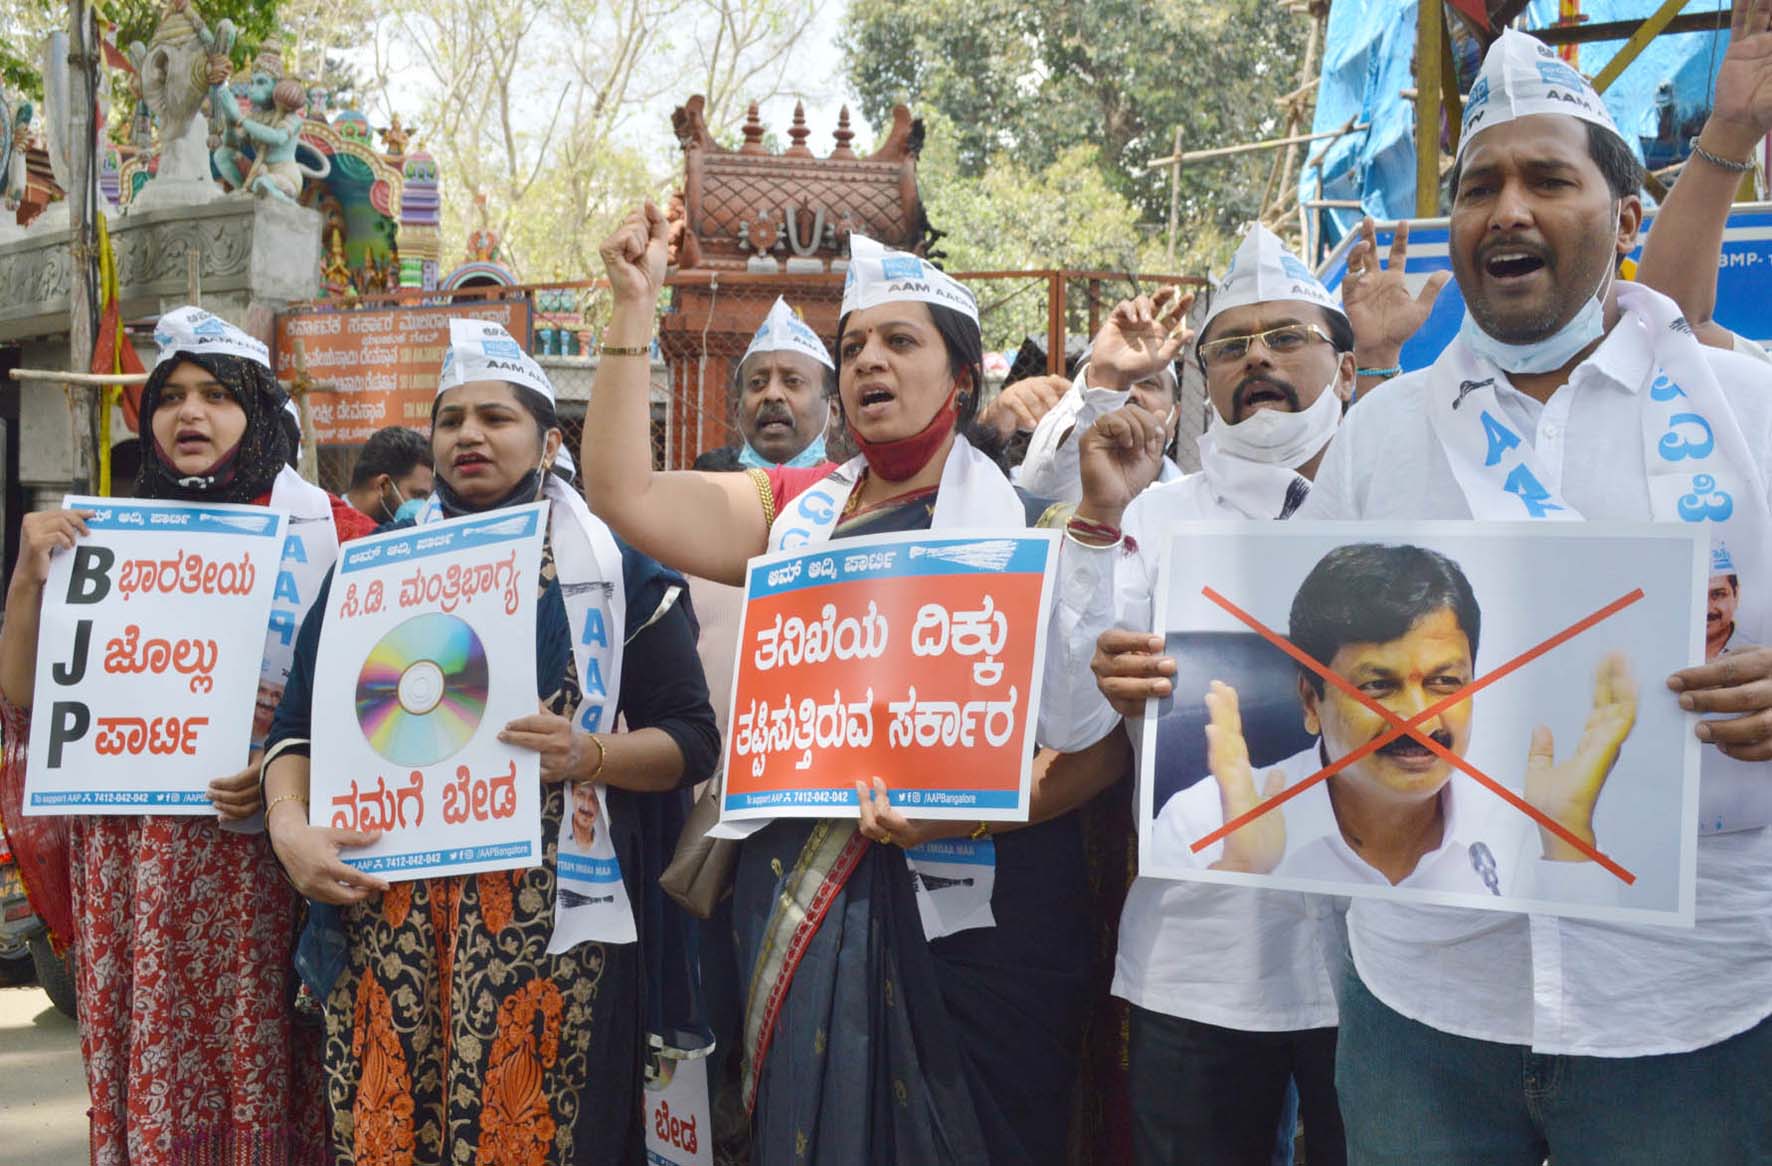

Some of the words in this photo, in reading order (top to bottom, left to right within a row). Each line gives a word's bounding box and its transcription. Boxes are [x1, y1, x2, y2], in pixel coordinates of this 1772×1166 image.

[888, 281, 930, 293] AAM
[487, 360, 525, 374] AAM
[65, 545, 116, 605] B
[118, 549, 256, 602] ಭಾರತೀಯ
[339, 578, 387, 620] ಸಿ.ಡಿ.
[399, 548, 521, 616] ಮಂತ್ರಿಭಾಗ್ಯ
[844, 551, 897, 573] ಪಾರ್ಟಿ
[52, 619, 94, 686] J
[103, 624, 219, 693] ಜೊಲ್ಲು
[754, 600, 889, 671] ತನಿಖೆಯ
[911, 594, 1008, 686] ದಿಕ್ಕು
[46, 700, 91, 769] P
[94, 716, 210, 756] ಪಾರ್ಟಿ
[736, 686, 874, 778] ತಪ್ಪಿಸುತ್ತಿರುವ
[888, 685, 1018, 750] ಸರ್ಕಾರ
[94, 792, 149, 802] 7412-042-042
[331, 770, 425, 833] ನಮಗೆ
[442, 759, 517, 825] ಬೇಡ
[794, 791, 848, 803] 7412-042-042
[924, 792, 977, 806] /AAPBangalore
[385, 852, 441, 868] 7412-042-042
[477, 844, 528, 859] /AAPBangalore
[655, 1099, 698, 1155] ಬೇಡ
